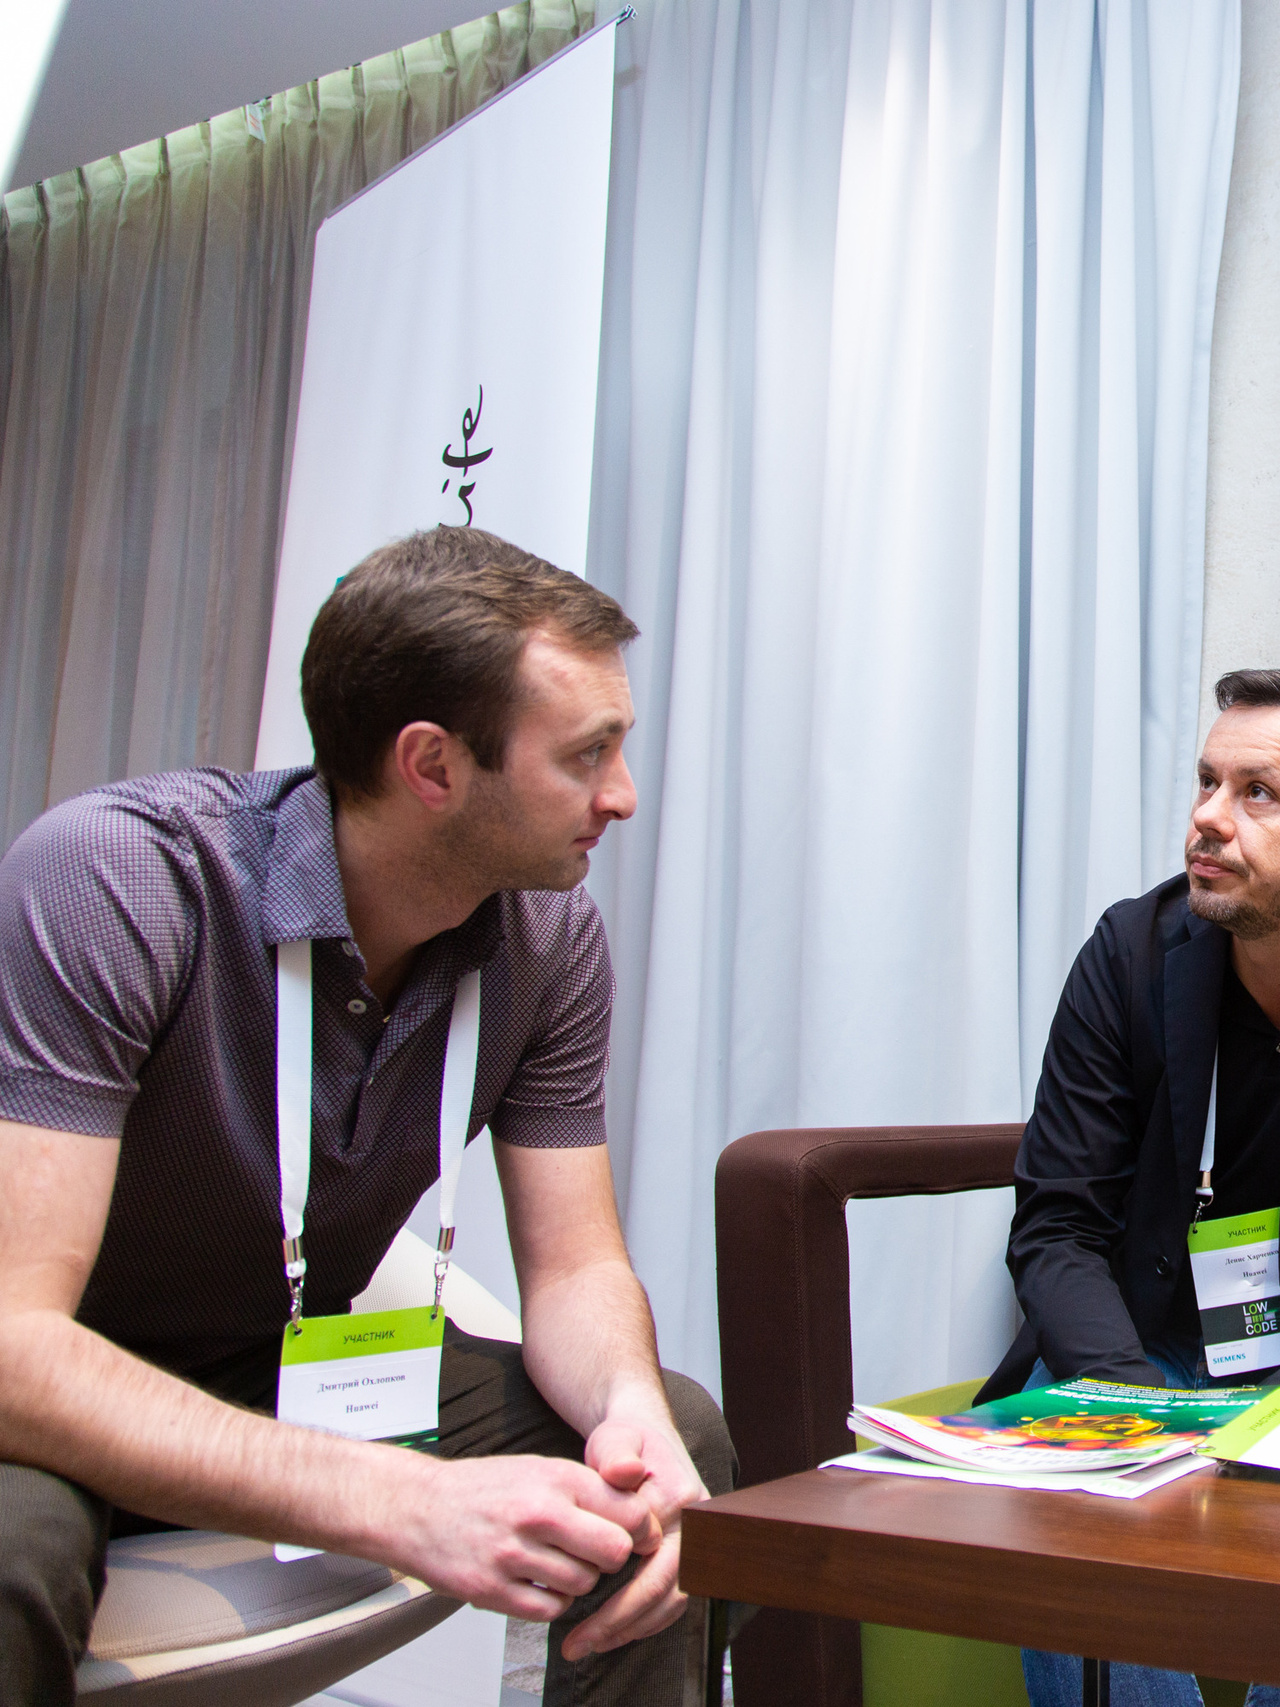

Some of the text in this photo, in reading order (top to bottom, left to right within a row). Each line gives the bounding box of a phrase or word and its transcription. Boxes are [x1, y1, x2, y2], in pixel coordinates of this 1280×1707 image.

[1227, 1225, 1268, 1238] УЧАСТНИК
[1225, 1257, 1245, 1265] Денис
[1242, 1268, 1267, 1278] Huawei
[1242, 1301, 1268, 1316] LOW
[1245, 1319, 1278, 1336] CODE
[343, 1329, 396, 1345] УЧАСТНИК
[1212, 1352, 1246, 1365] SIEMENS
[317, 1374, 406, 1394] Дмитрий Охлопков
[345, 1400, 379, 1414] Huawei
